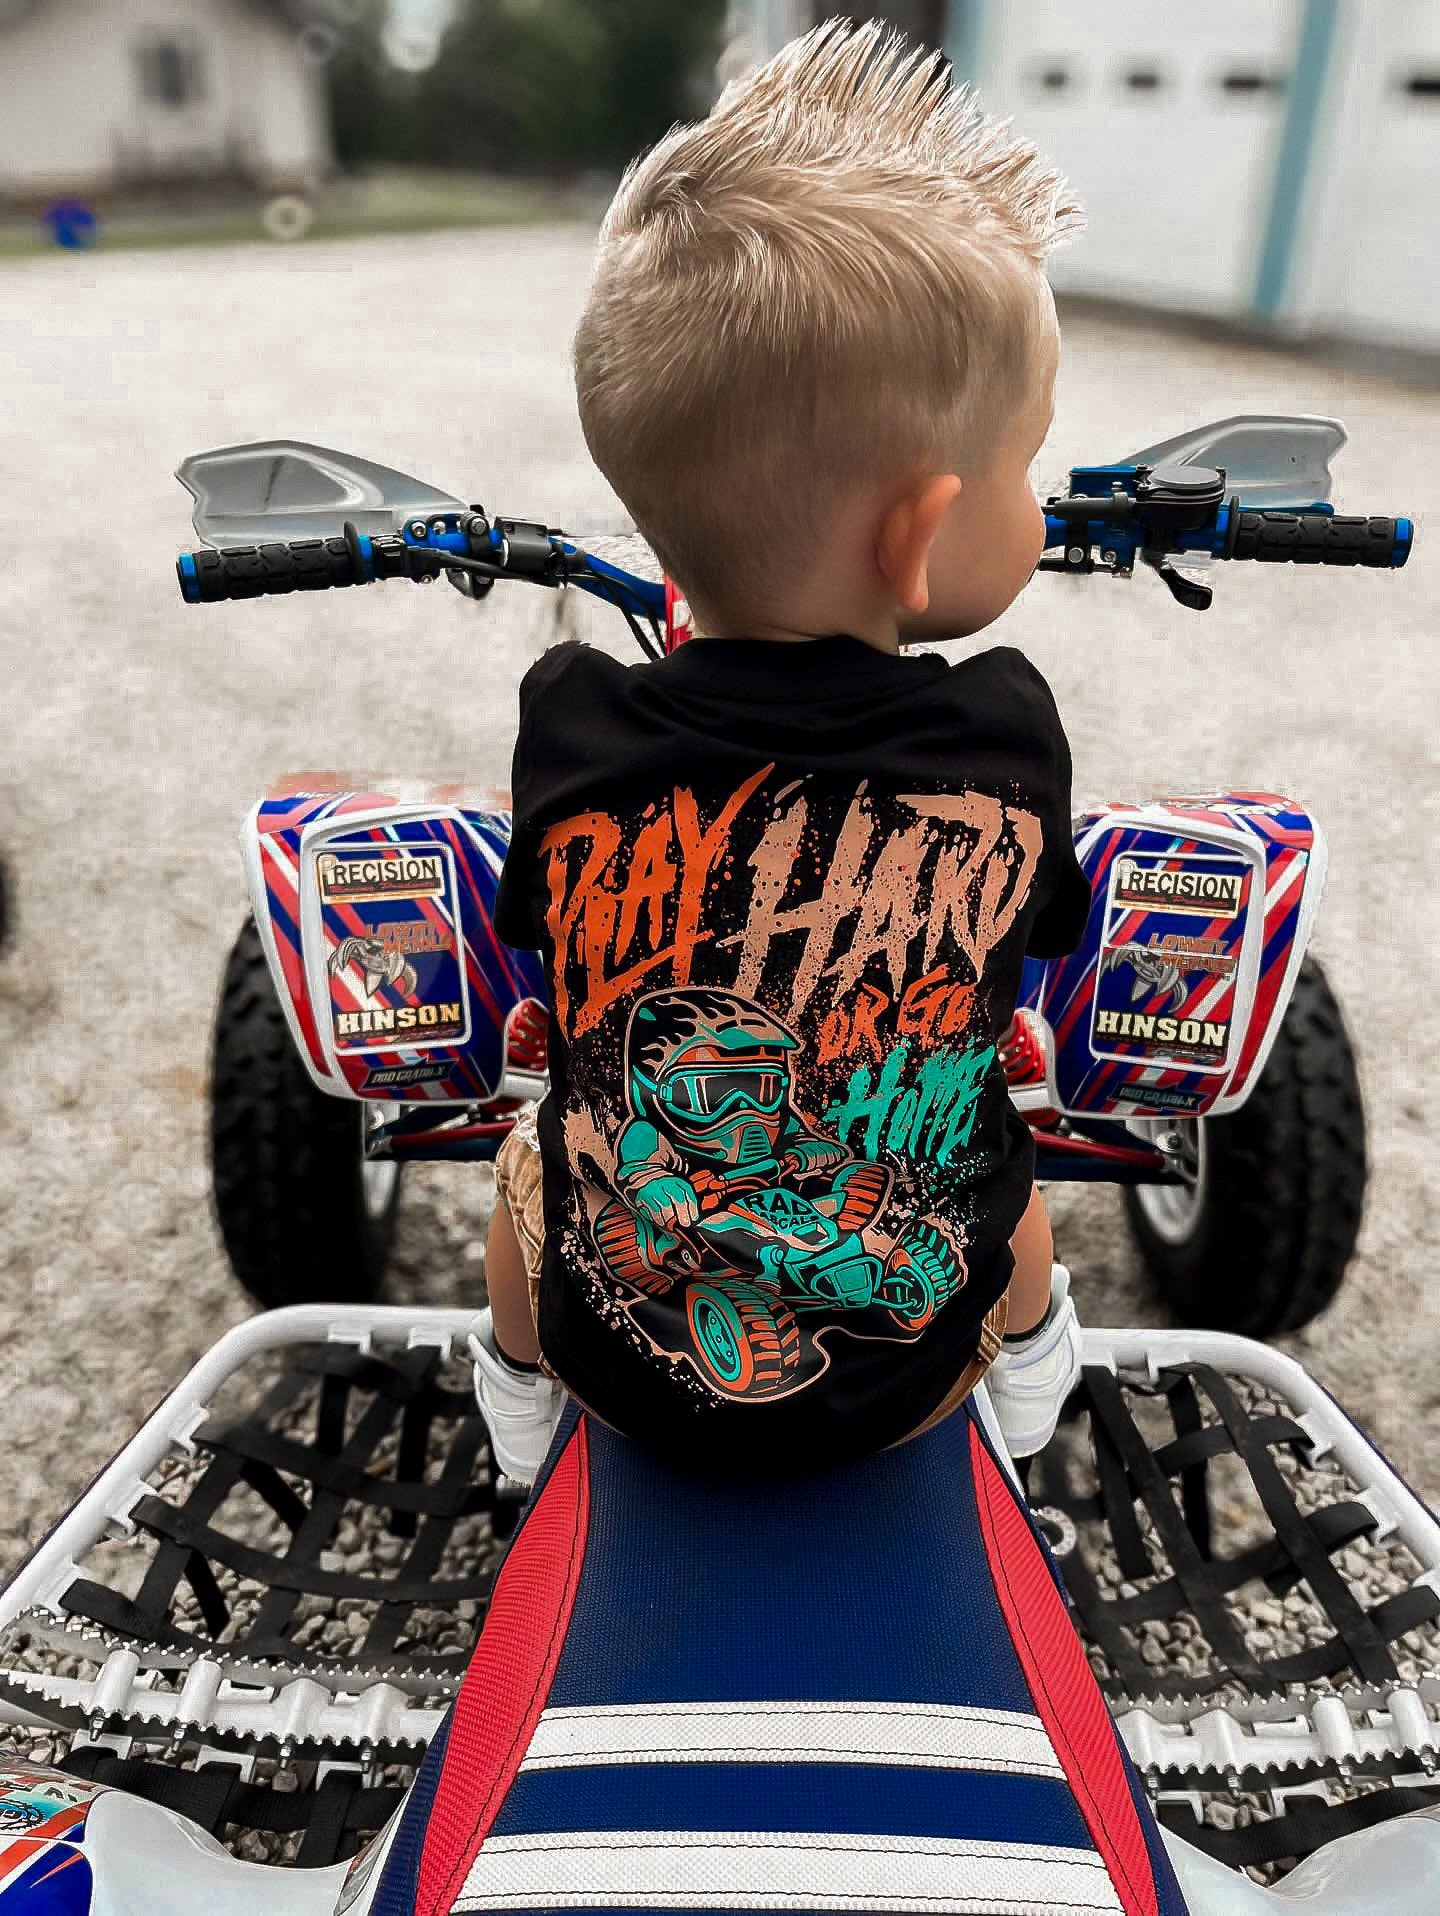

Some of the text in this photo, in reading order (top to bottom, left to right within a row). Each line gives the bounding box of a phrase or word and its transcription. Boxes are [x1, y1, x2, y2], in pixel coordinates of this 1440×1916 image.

[716, 774, 1043, 1022] HARD
[337, 1003, 460, 1035] HINSON
[1097, 1010, 1226, 1047] HINSON
[744, 1192, 813, 1215] RAD
